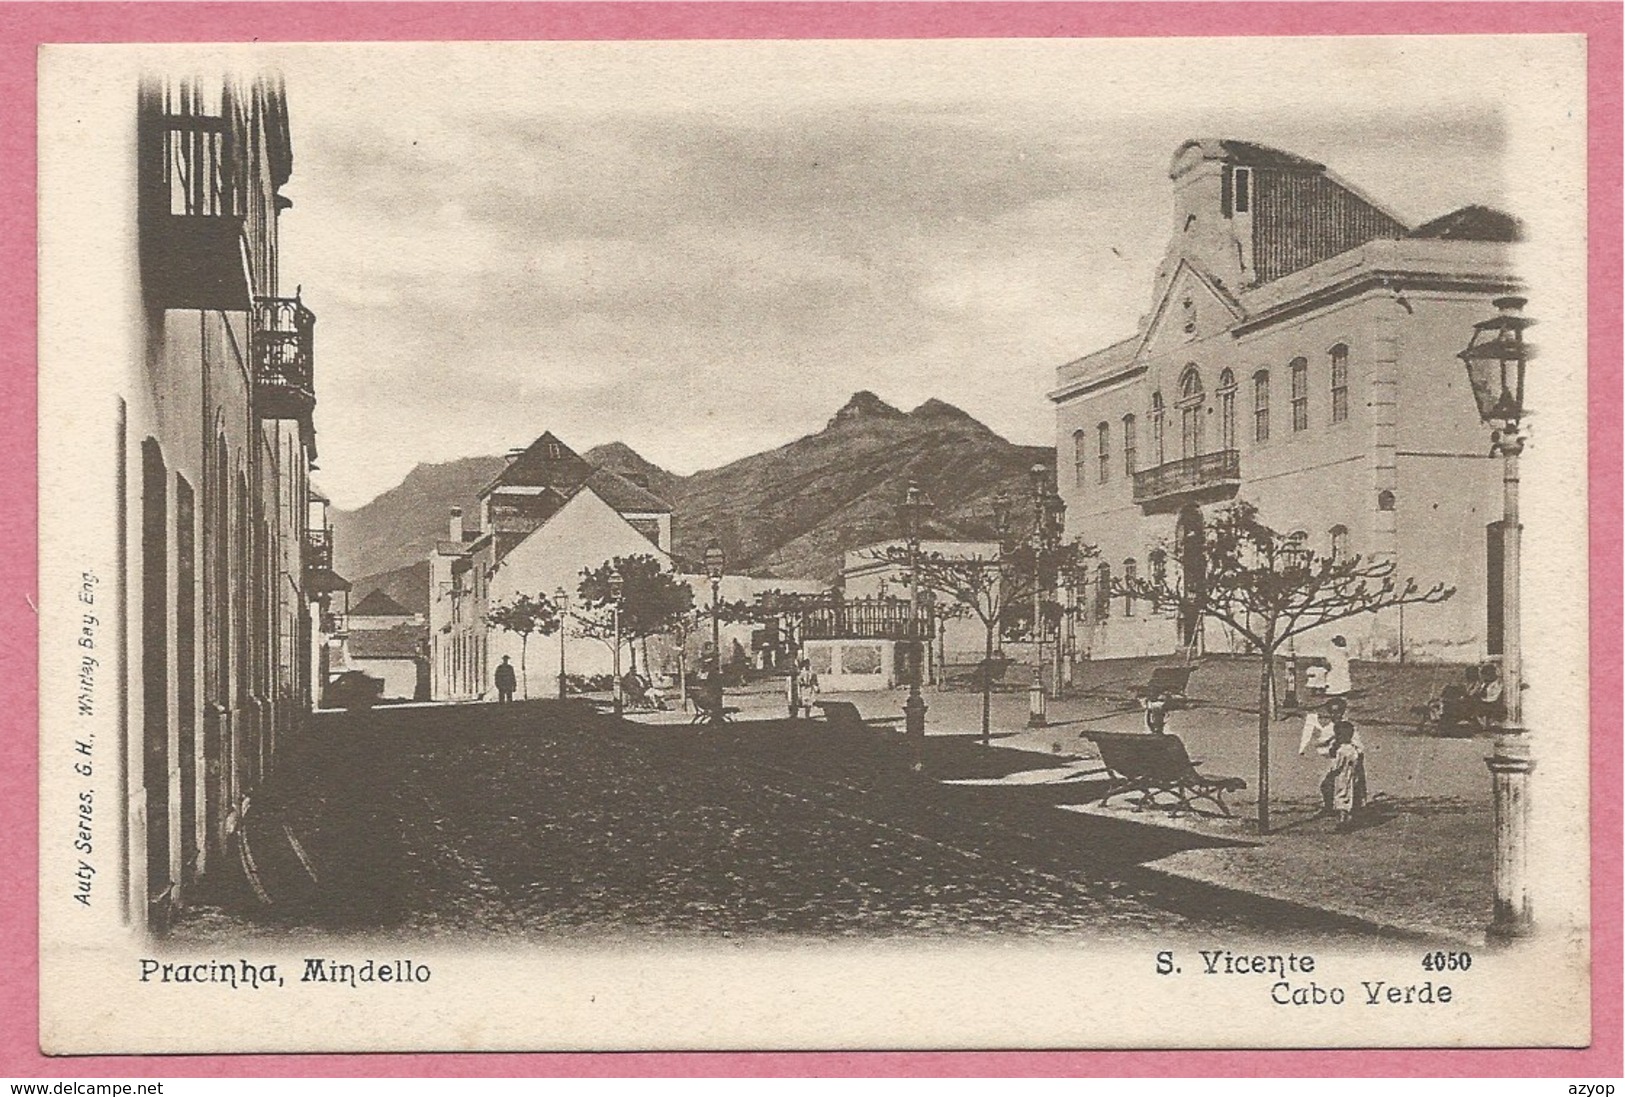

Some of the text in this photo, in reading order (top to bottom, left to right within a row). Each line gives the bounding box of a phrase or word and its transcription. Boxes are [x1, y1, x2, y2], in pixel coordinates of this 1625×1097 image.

[73, 859, 97, 907] Auty
[140, 958, 431, 989] Pracinha, Mindello
[1156, 950, 1315, 978] S. Vicente
[1421, 951, 1472, 972] 4050
[1271, 981, 1453, 1006] Cabo Verde
